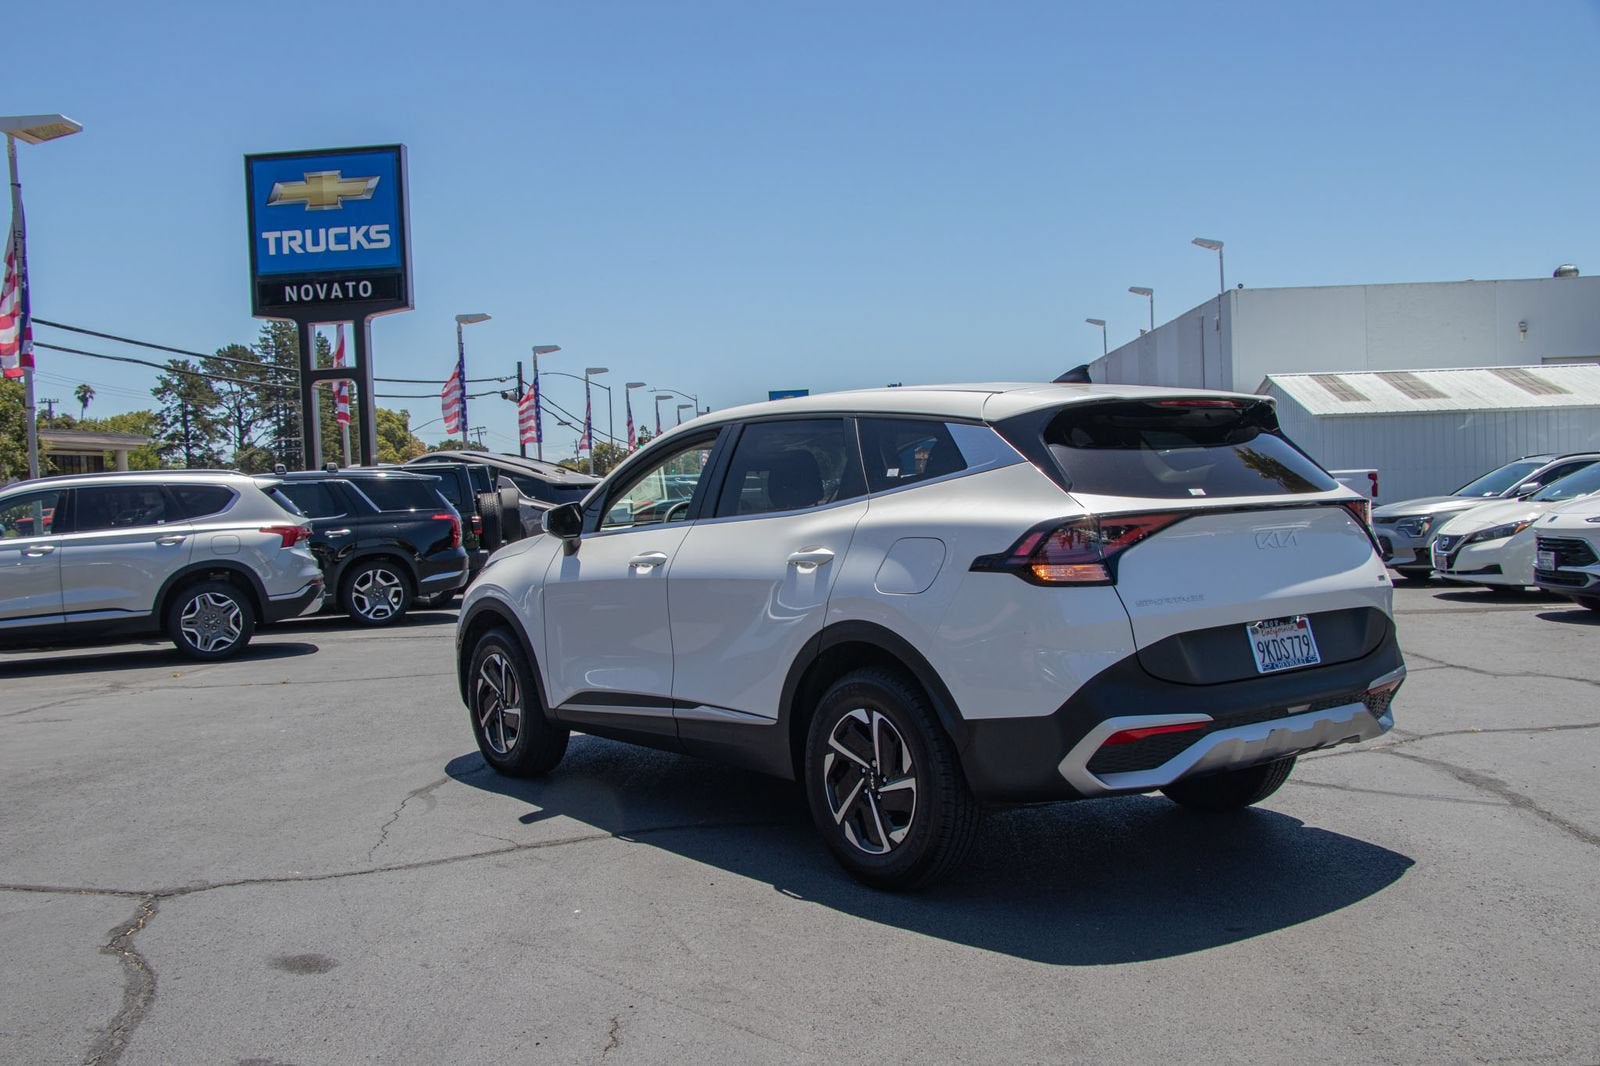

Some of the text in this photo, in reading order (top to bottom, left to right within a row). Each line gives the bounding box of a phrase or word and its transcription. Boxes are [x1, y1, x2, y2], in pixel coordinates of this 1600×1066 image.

[262, 224, 391, 256] TRUCKS
[285, 281, 372, 302] NOVATO
[1256, 634, 1311, 663] 9KDS779
